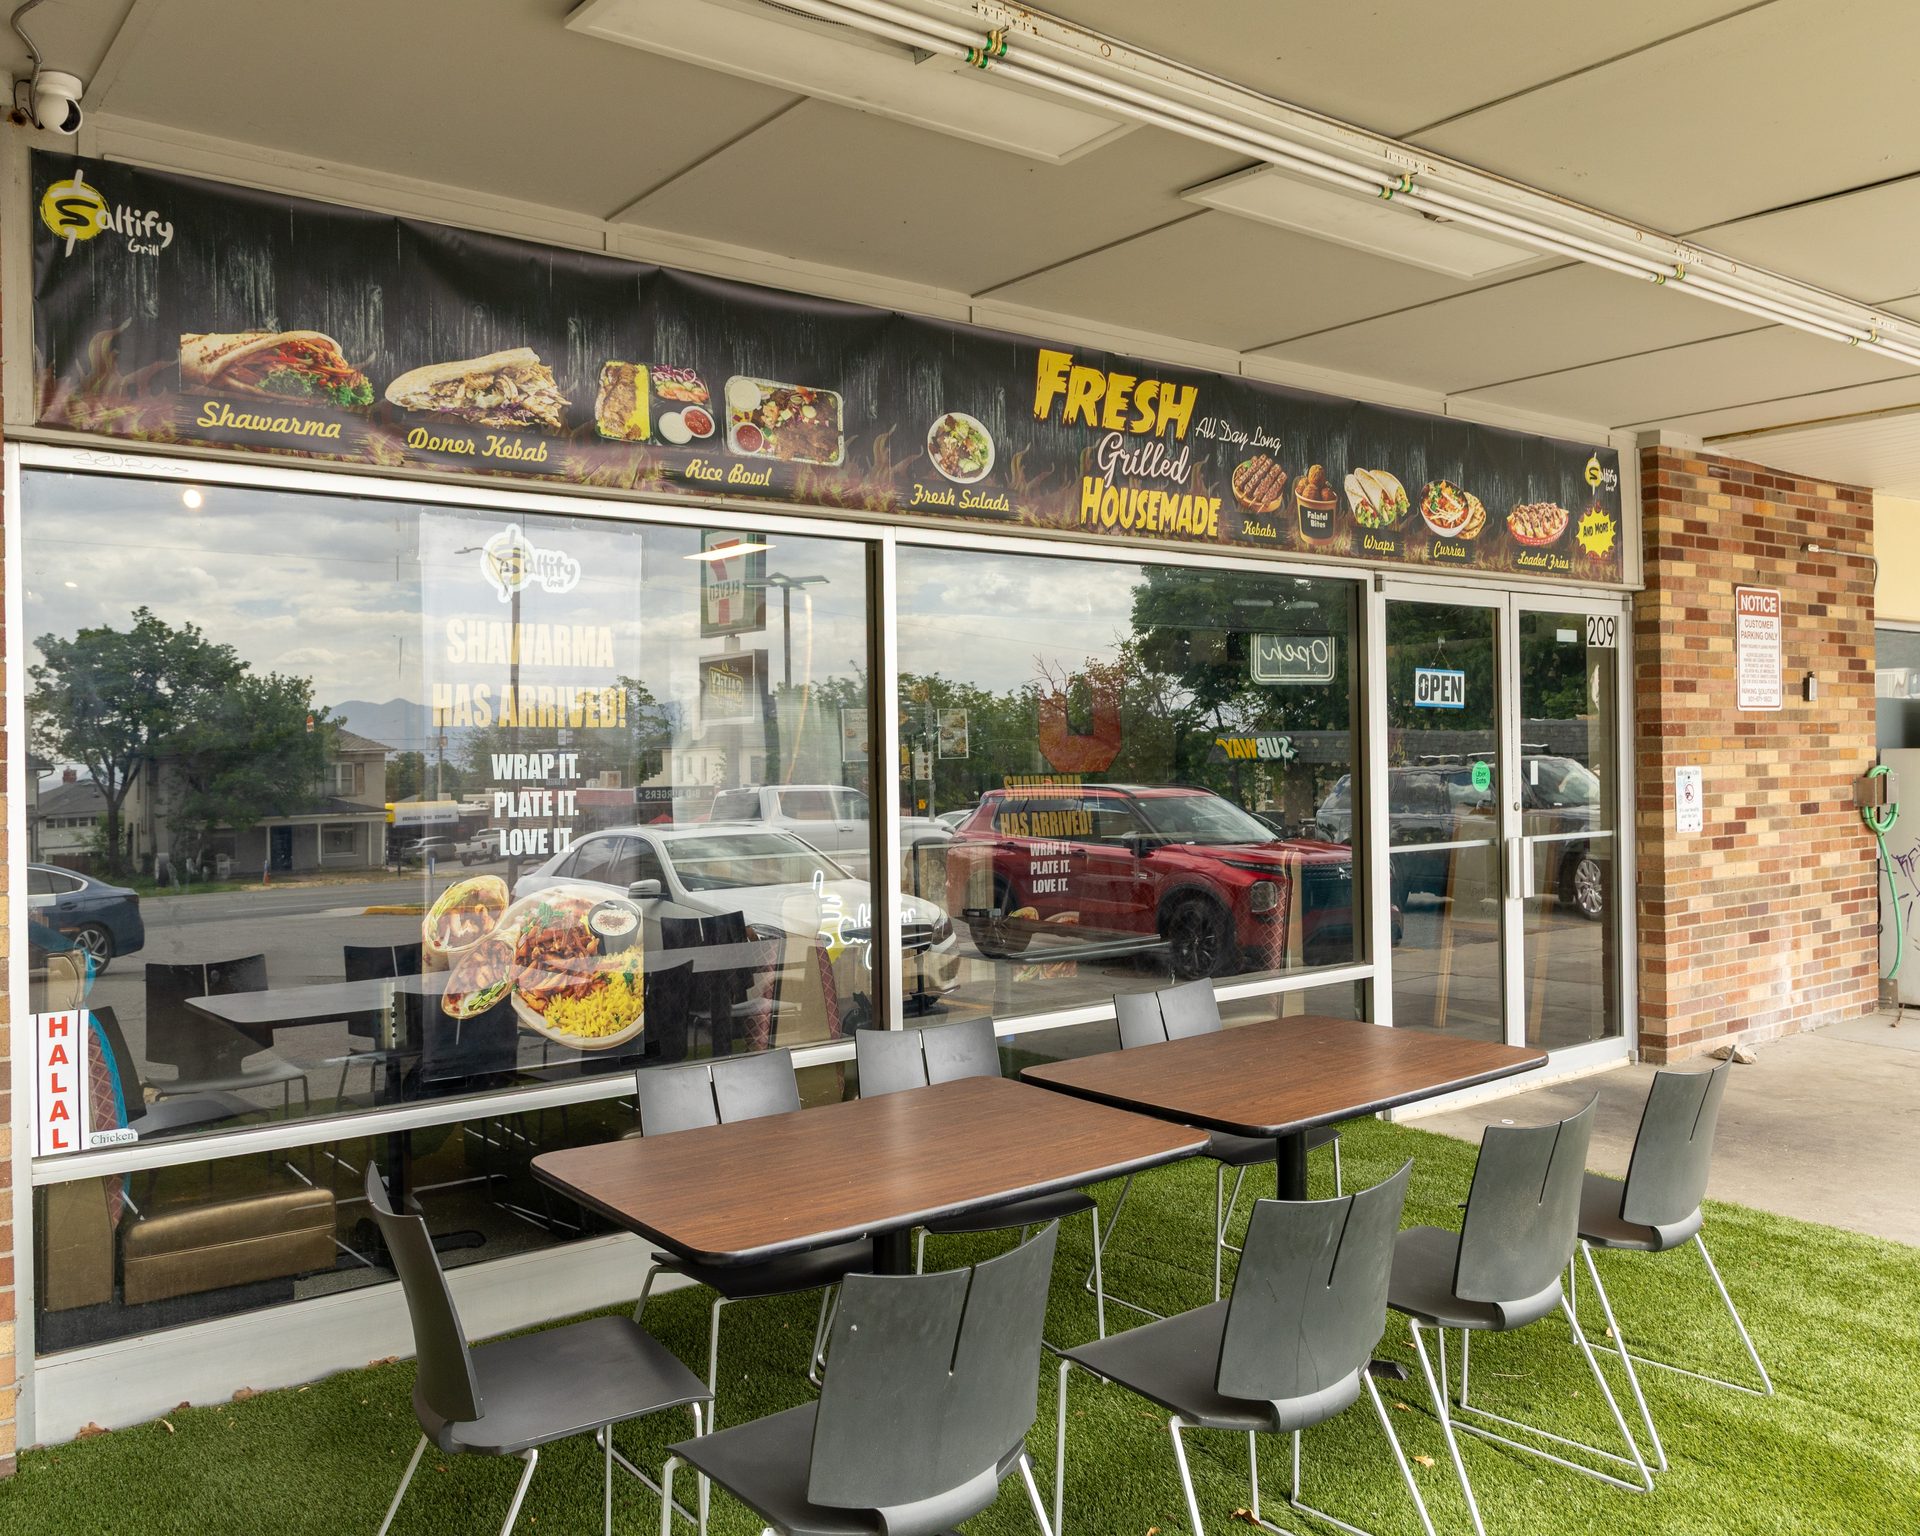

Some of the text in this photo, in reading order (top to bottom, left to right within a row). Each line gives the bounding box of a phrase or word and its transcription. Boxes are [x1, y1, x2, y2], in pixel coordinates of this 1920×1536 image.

[55, 198, 174, 248] Saltify
[128, 238, 160, 256] Grill
[1033, 349, 1198, 440] FRESH
[196, 401, 342, 439] Shawarma
[407, 427, 548, 462] Doner Kebab
[1195, 417, 1282, 456] All Day Long
[685, 459, 772, 487] Rice Bowl
[1097, 432, 1191, 488] Grilled
[910, 483, 1009, 512] Fresh Salads
[1080, 476, 1221, 537] HOUSEMADE
[1241, 520, 1277, 538] Kebabs
[1307, 510, 1328, 521] Falafel
[1310, 520, 1326, 529] Bites
[1583, 525, 1593, 537] AND
[1364, 535, 1395, 555] Wraps
[1434, 541, 1466, 558] Curries
[1517, 551, 1569, 570] Loaded Fries
[1741, 594, 1777, 613] NOTICE
[1588, 616, 1614, 646] 209
[1740, 630, 1777, 640] PARKING ONLY
[1744, 619, 1774, 629] CUSTOMER
[446, 617, 615, 668] SHAWARMA
[1418, 673, 1462, 702] OPEN
[432, 683, 627, 728] HAS ARRIVED!
[491, 753, 581, 780] WRAP IT.
[1003, 775, 1084, 801] SHAWARMA
[494, 790, 579, 818] PLATE IT.
[1000, 809, 1093, 838] HAS ARRIVED!
[500, 827, 575, 856] LOVE IT.
[1030, 841, 1072, 857] WRAP IT.
[1030, 859, 1071, 875] PLATE IT.
[1033, 878, 1068, 893] LOVE IT.
[48, 1016, 70, 1149] HALAL
[91, 1131, 134, 1145] Chicken
